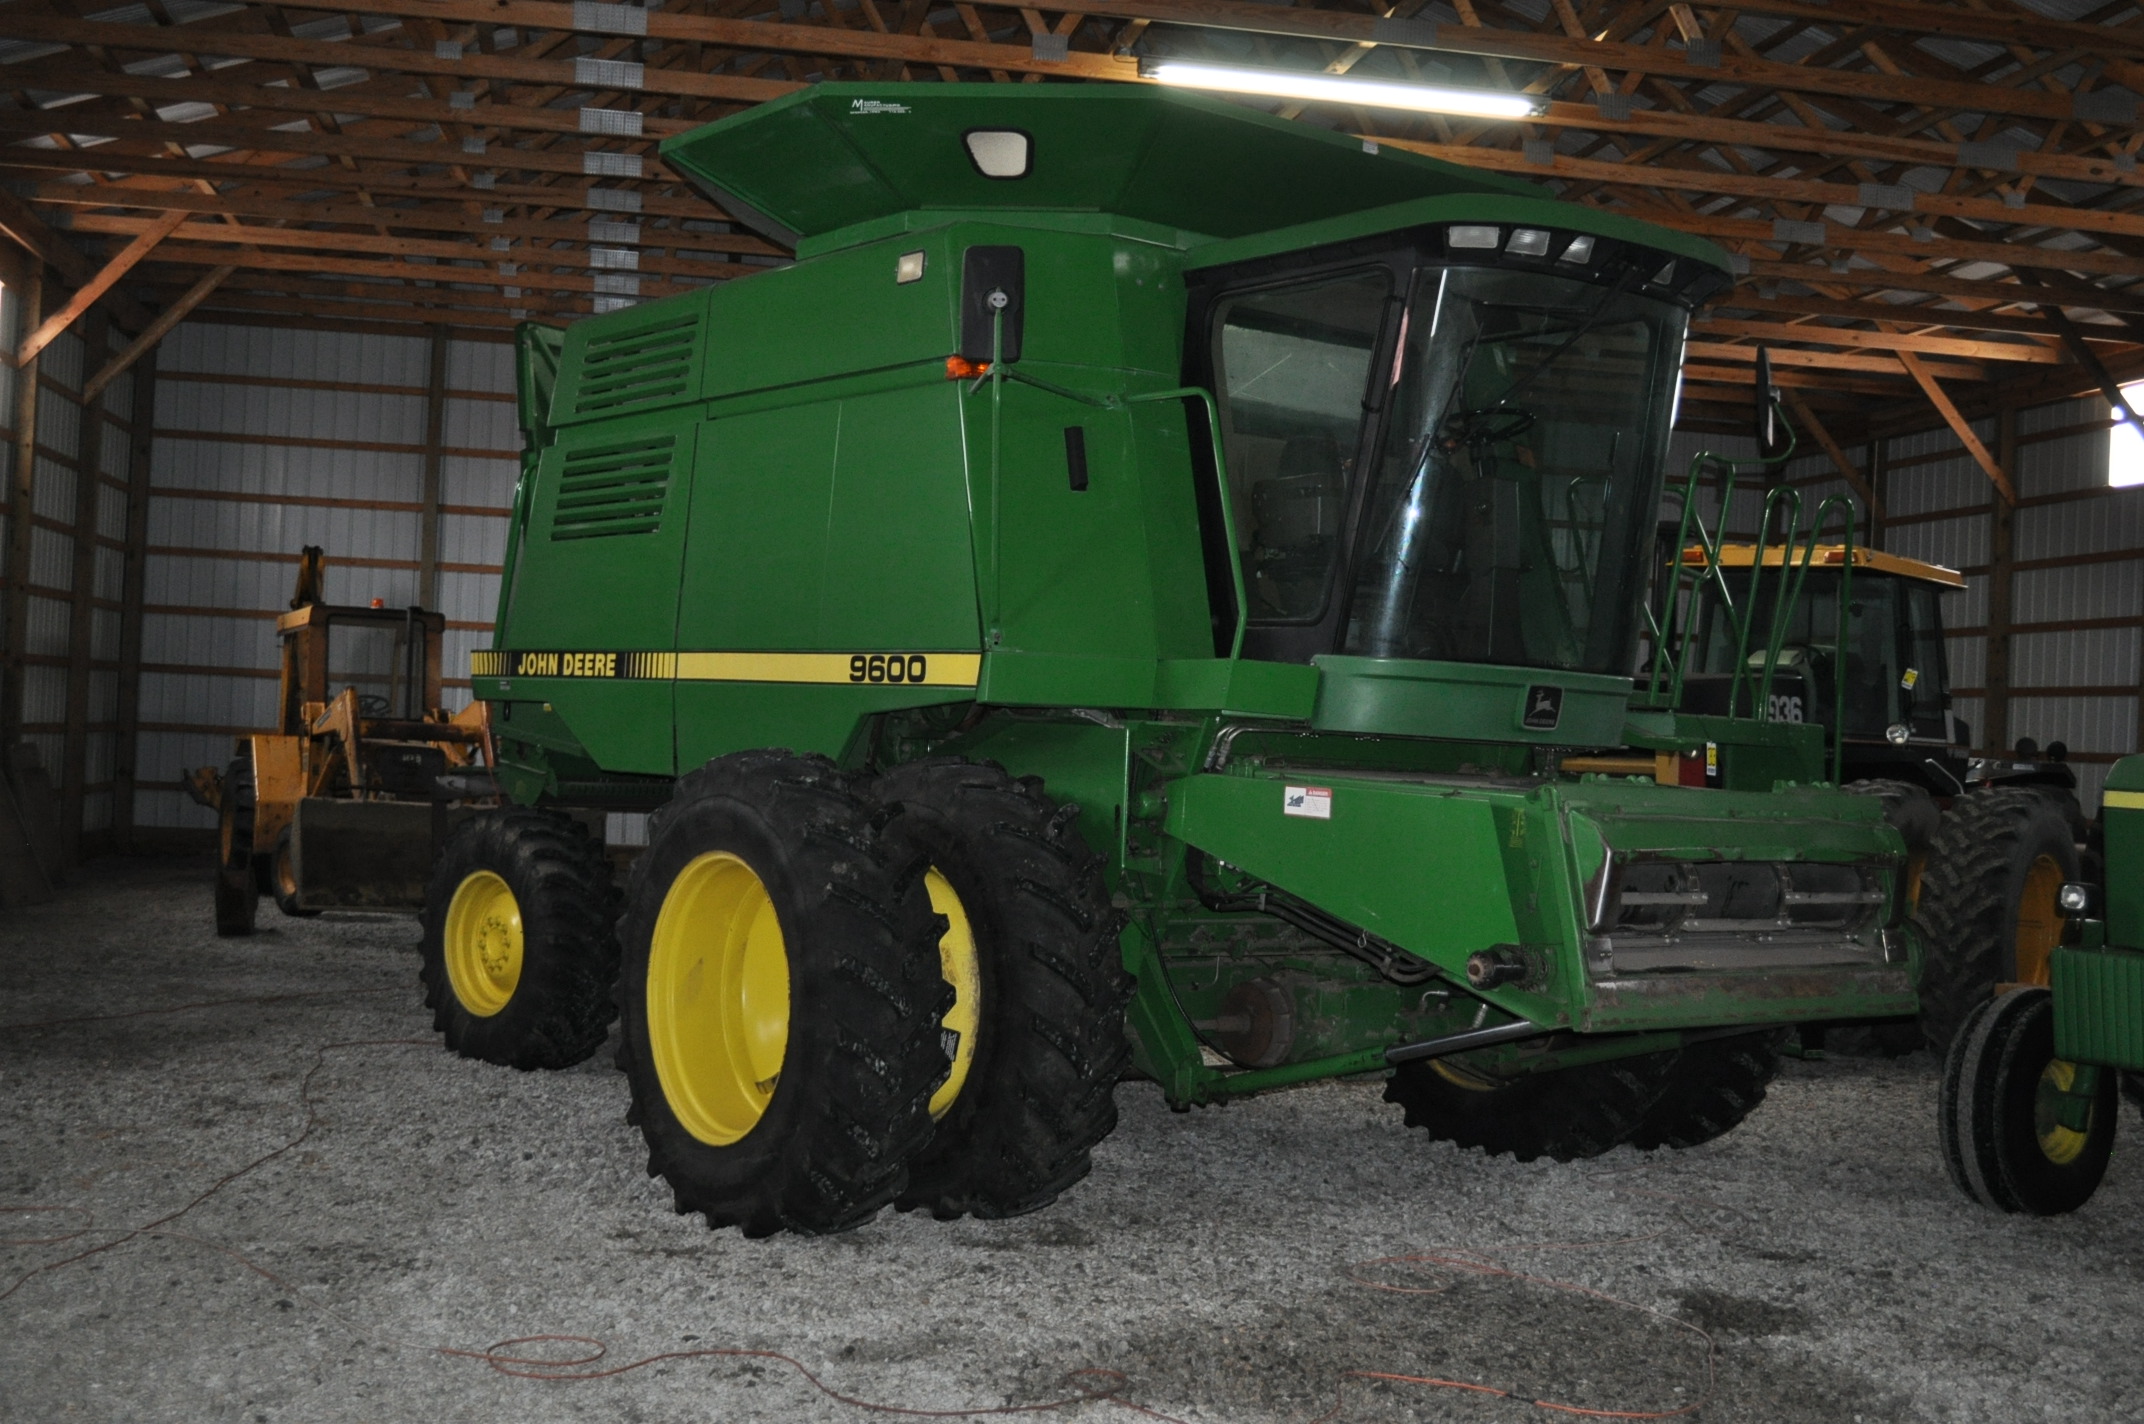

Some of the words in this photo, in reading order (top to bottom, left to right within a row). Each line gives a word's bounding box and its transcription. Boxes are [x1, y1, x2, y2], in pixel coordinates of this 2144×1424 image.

[518, 653, 558, 676] JOHN
[563, 653, 616, 677] DEERE
[849, 655, 927, 683] 9600
[1768, 695, 1803, 724] 936
